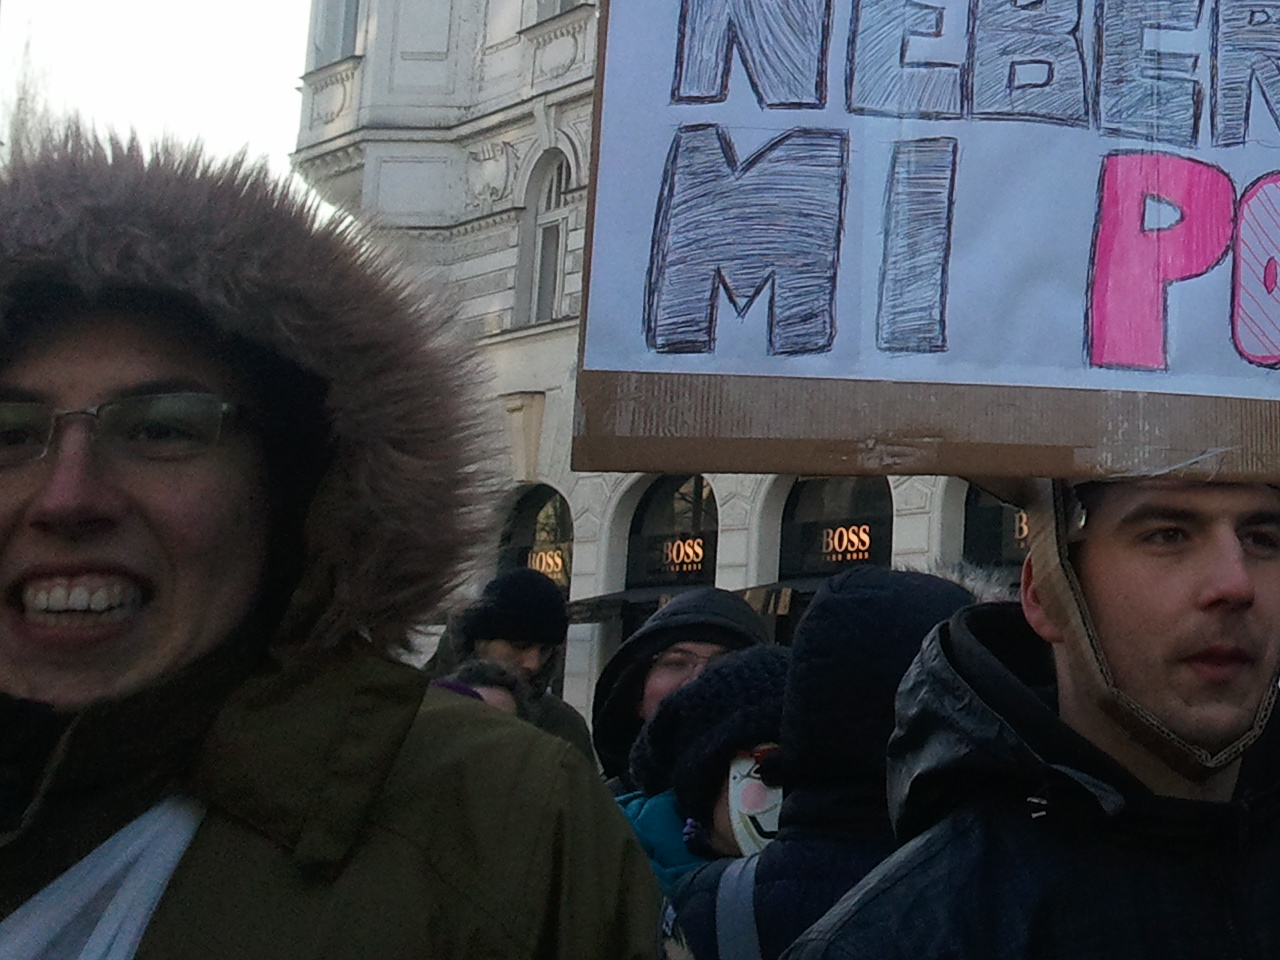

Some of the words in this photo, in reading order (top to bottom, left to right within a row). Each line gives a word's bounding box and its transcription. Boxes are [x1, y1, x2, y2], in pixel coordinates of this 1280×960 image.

[642, 123, 961, 356] MI
[663, 538, 704, 563] BOSS
[822, 524, 871, 553] BOSS
